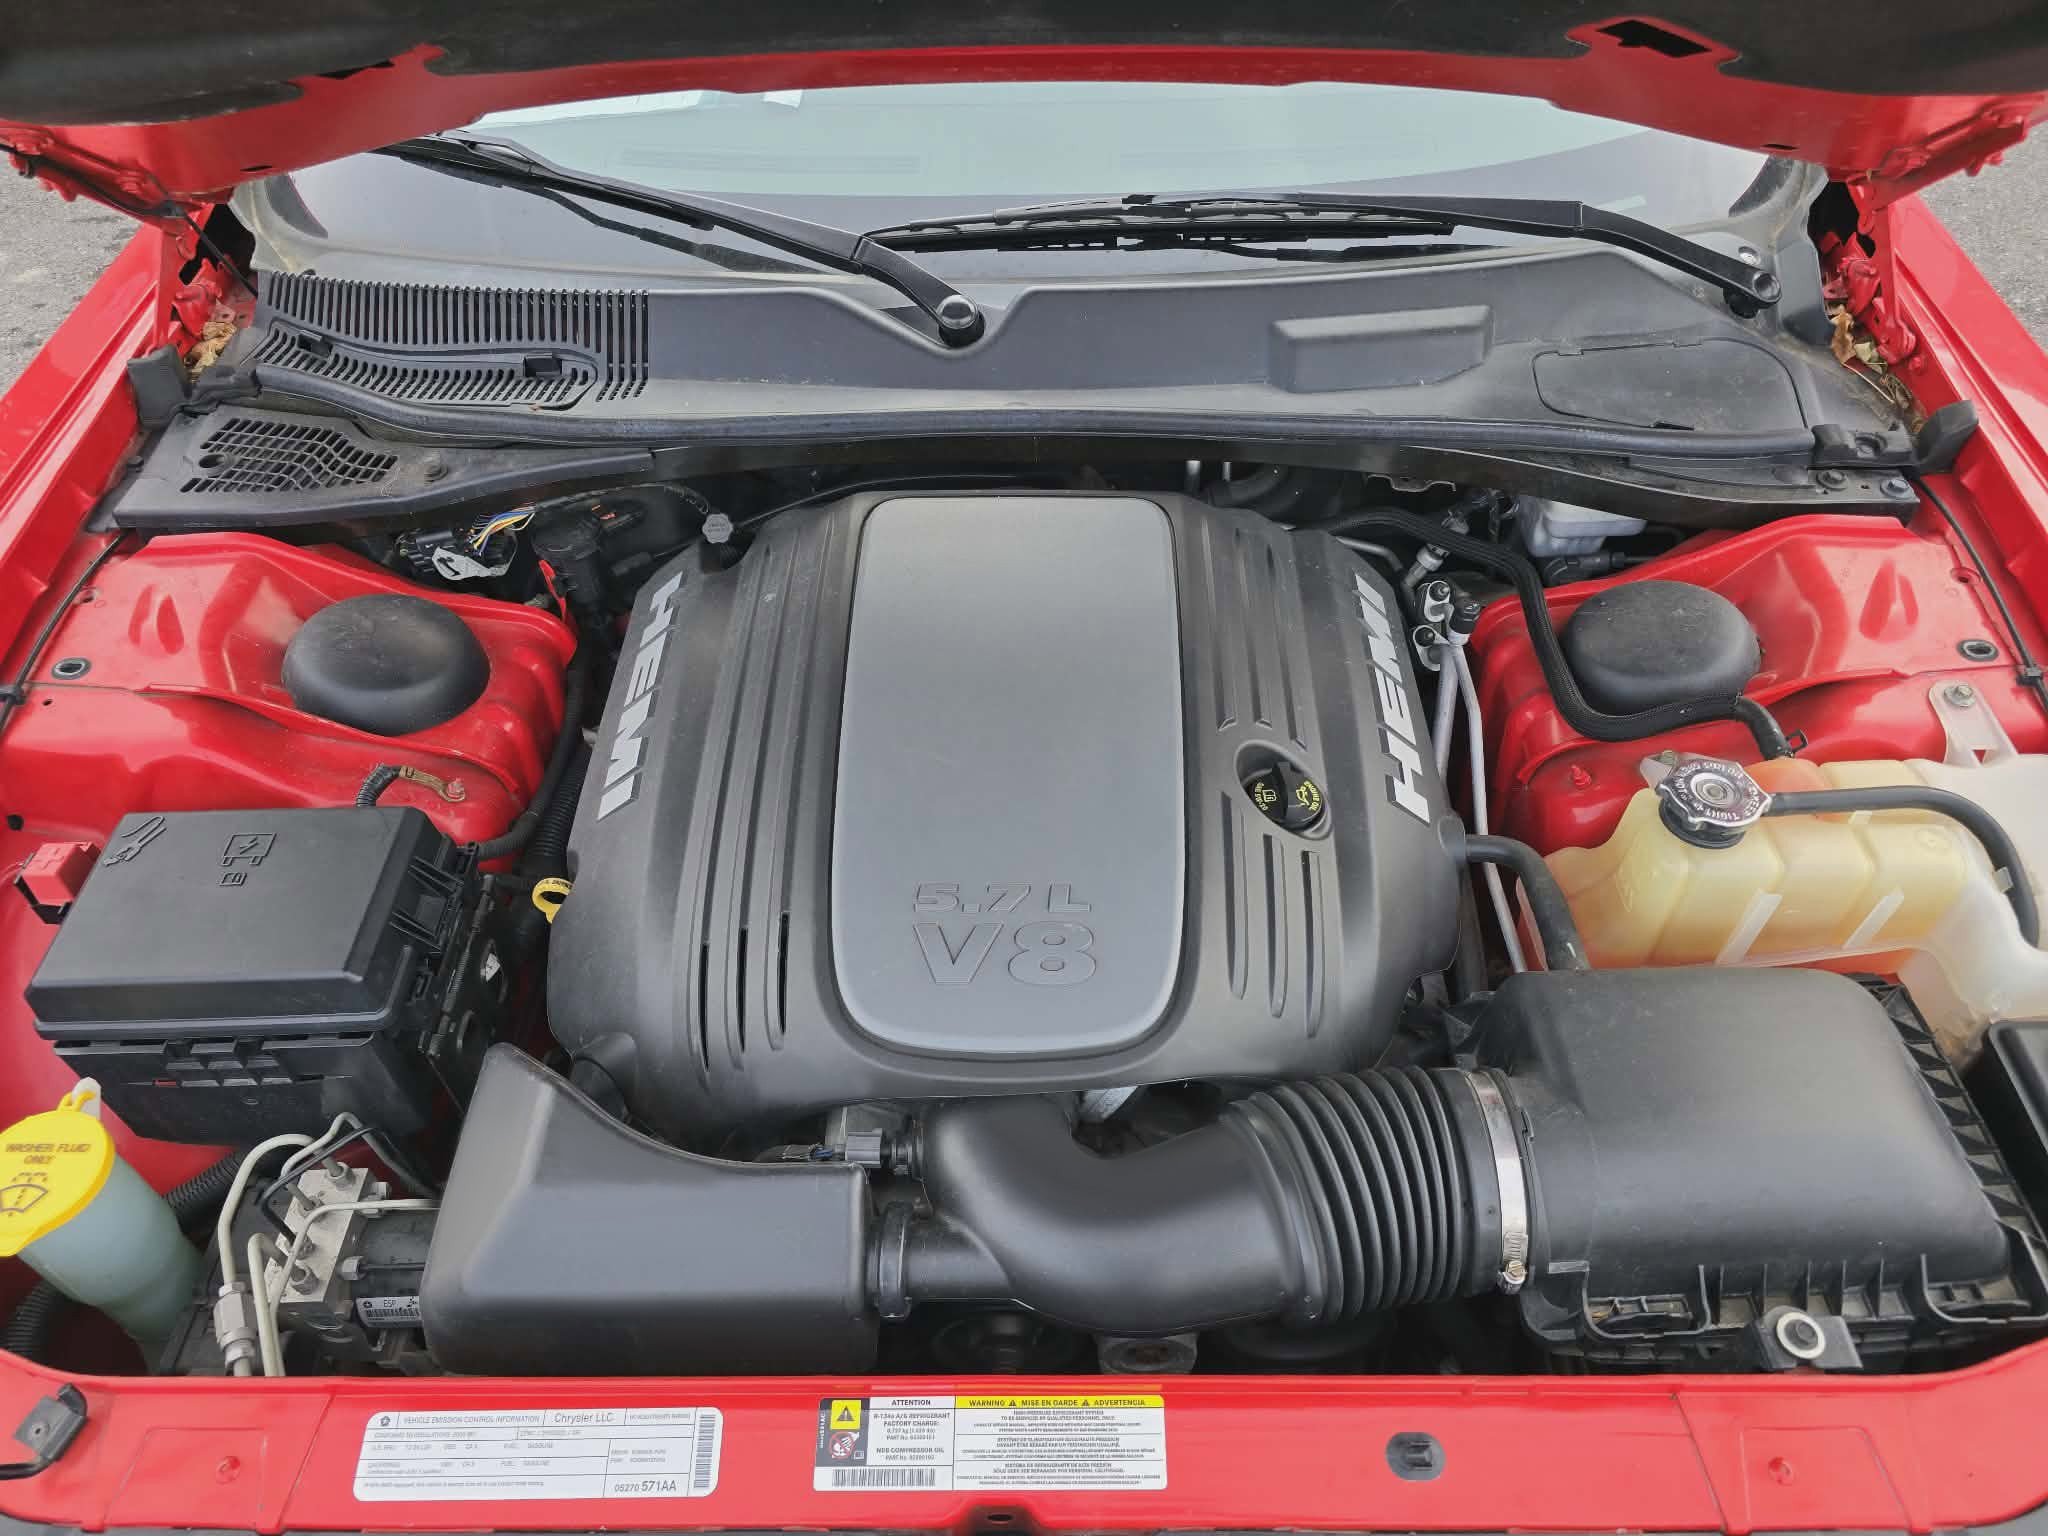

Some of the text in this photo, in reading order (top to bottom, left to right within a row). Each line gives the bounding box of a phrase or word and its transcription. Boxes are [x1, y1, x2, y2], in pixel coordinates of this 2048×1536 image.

[597, 571, 684, 822] HEMI
[1355, 573, 1431, 825] HEMI
[911, 919, 1098, 986] V8
[6, 1143, 92, 1153] WASHER FLUID
[23, 1155, 56, 1165] ONLY
[969, 1399, 1006, 1407] WARNING
[1021, 1399, 1079, 1407] MISE EN GARDE
[1094, 1398, 1146, 1407] ADVERTENCIA
[403, 1414, 541, 1425] VEHICLE EMISSION CONTROL INFORMATION
[553, 1412, 593, 1425] Chrysler
[595, 1411, 618, 1423] LLC
[883, 1420, 912, 1428] FACTORY
[614, 1479, 677, 1493] 05270 571AA
